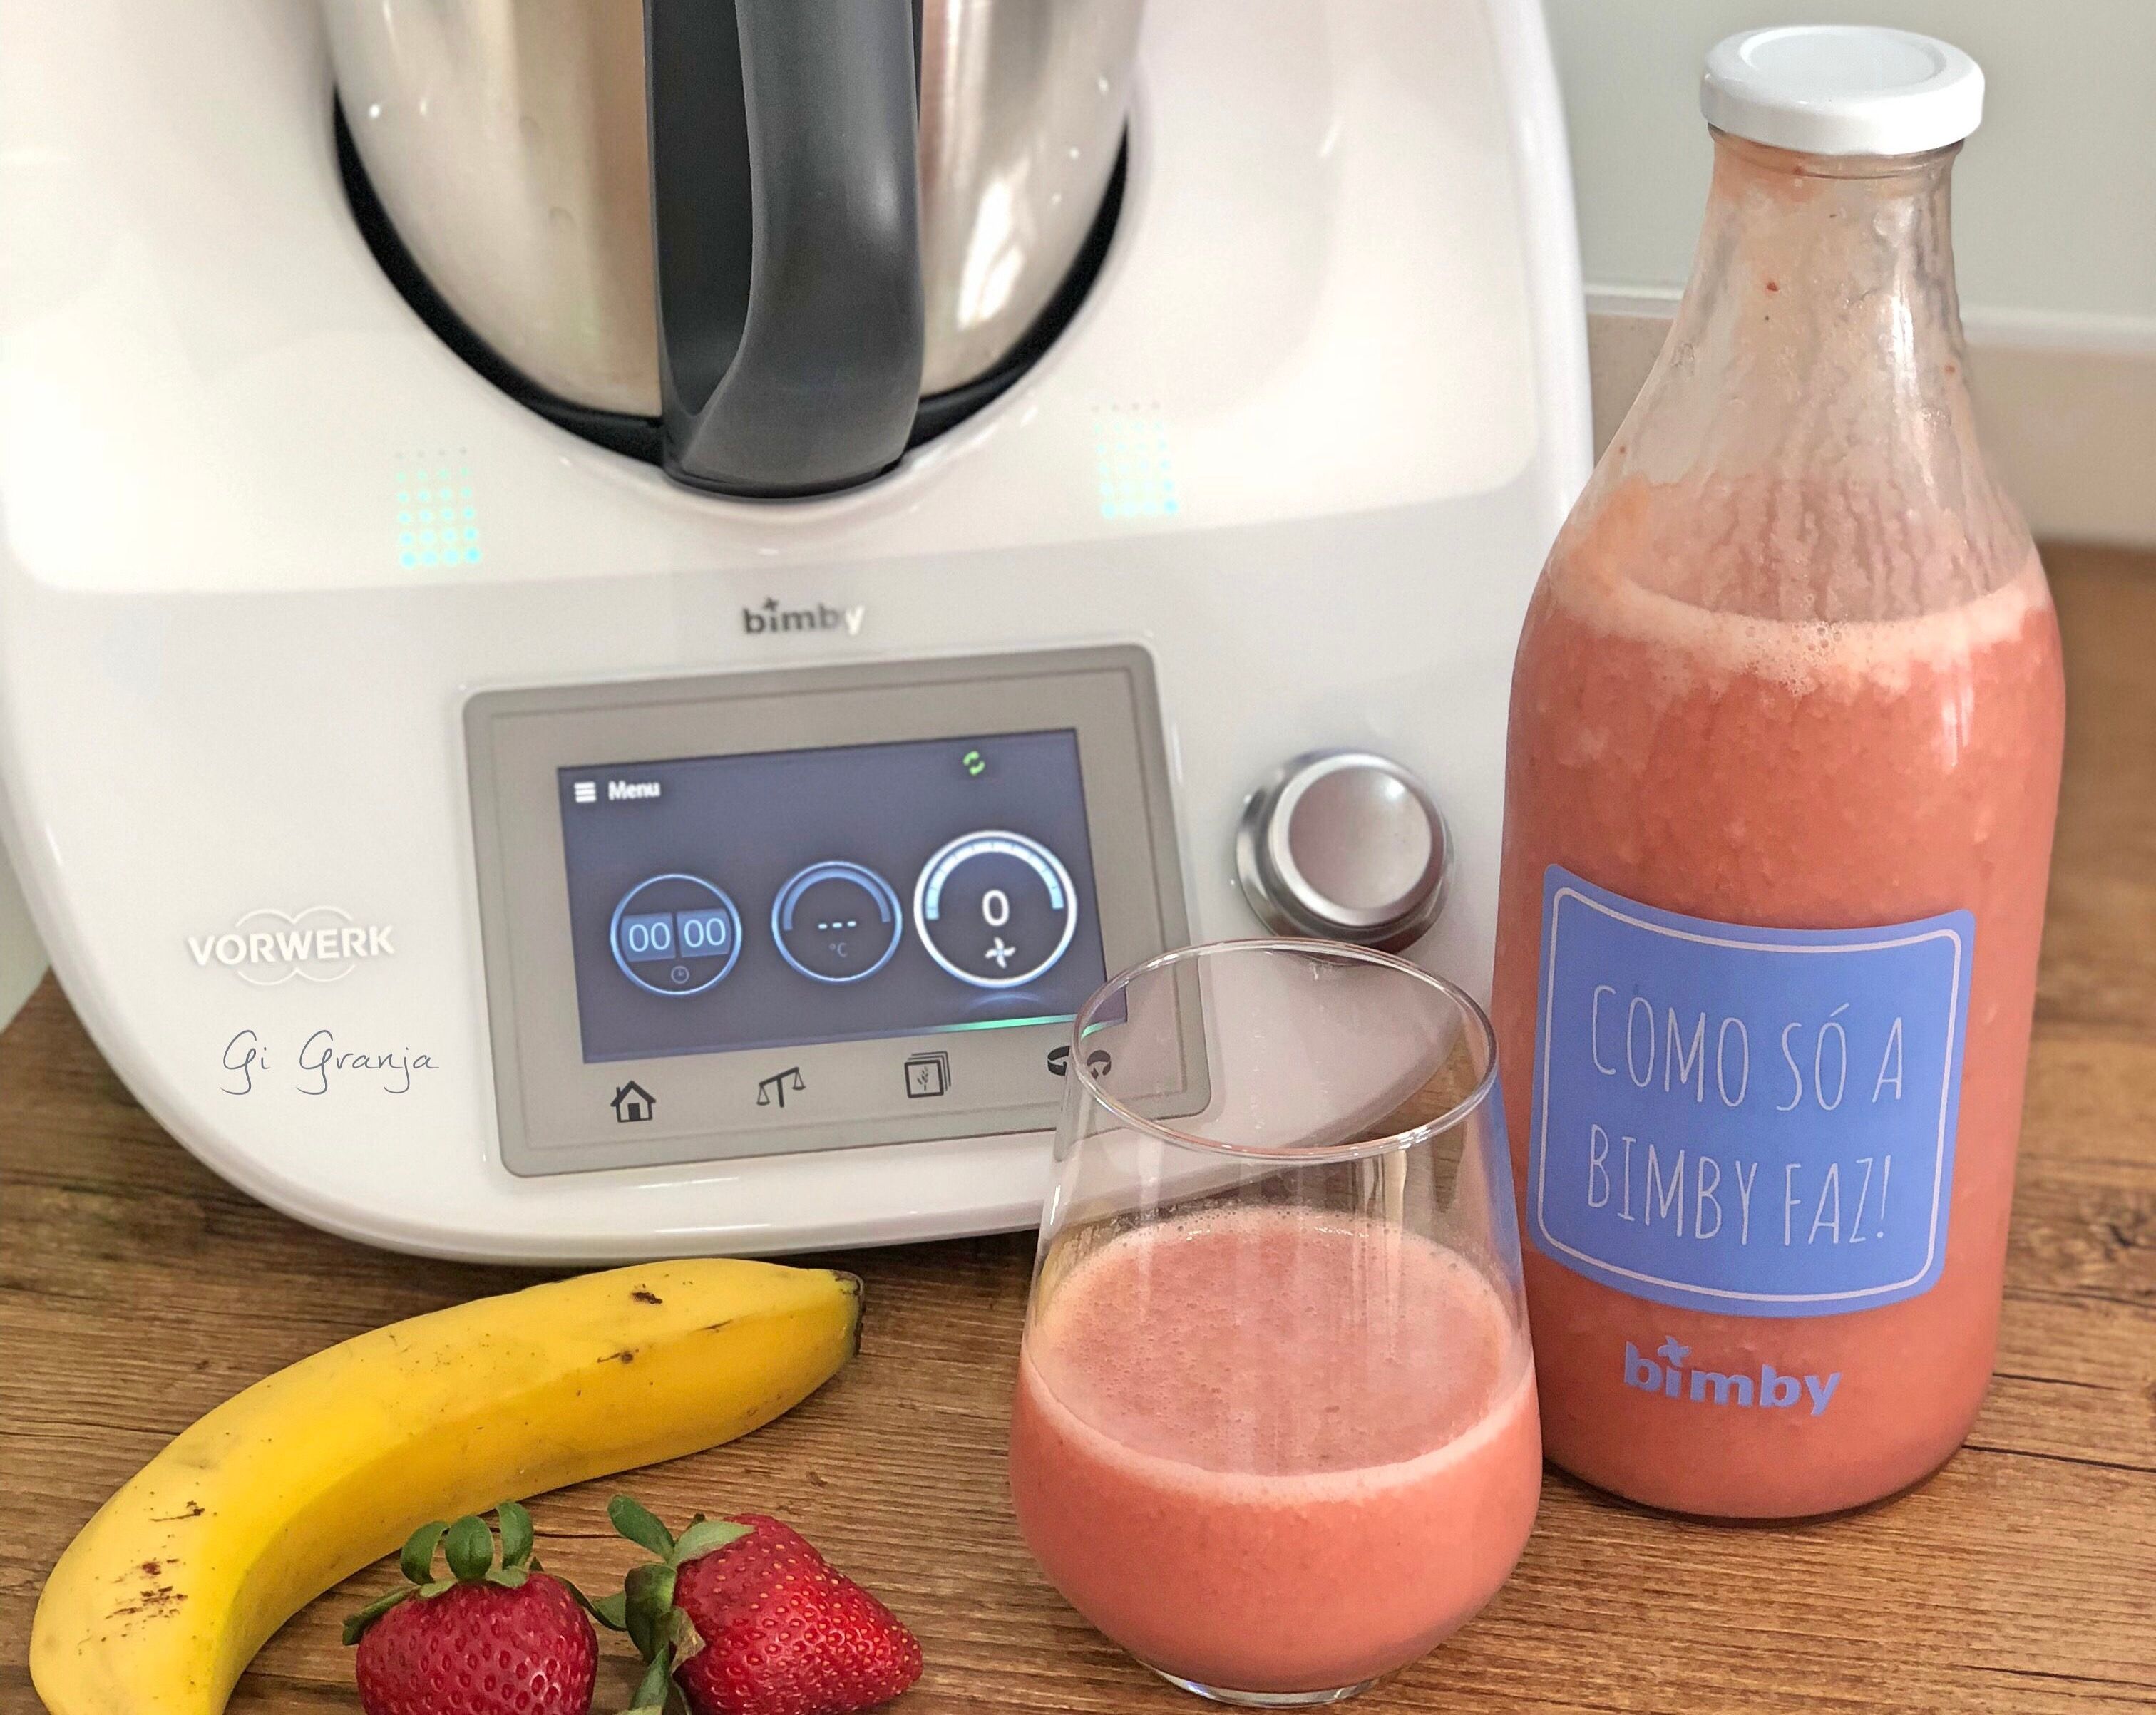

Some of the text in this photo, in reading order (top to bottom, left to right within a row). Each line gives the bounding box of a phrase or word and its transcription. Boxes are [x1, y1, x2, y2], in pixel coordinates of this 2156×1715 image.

[742, 597, 865, 636] bimby
[607, 780, 661, 801] Menu
[982, 890, 1010, 927] 0
[188, 925, 396, 967] VORWERK
[628, 917, 727, 952] 00 00
[1591, 984, 1904, 1111] COMO SÓ A
[1587, 1123, 1892, 1247] BIMBY FAZ!
[1623, 1334, 1843, 1418] bimby
